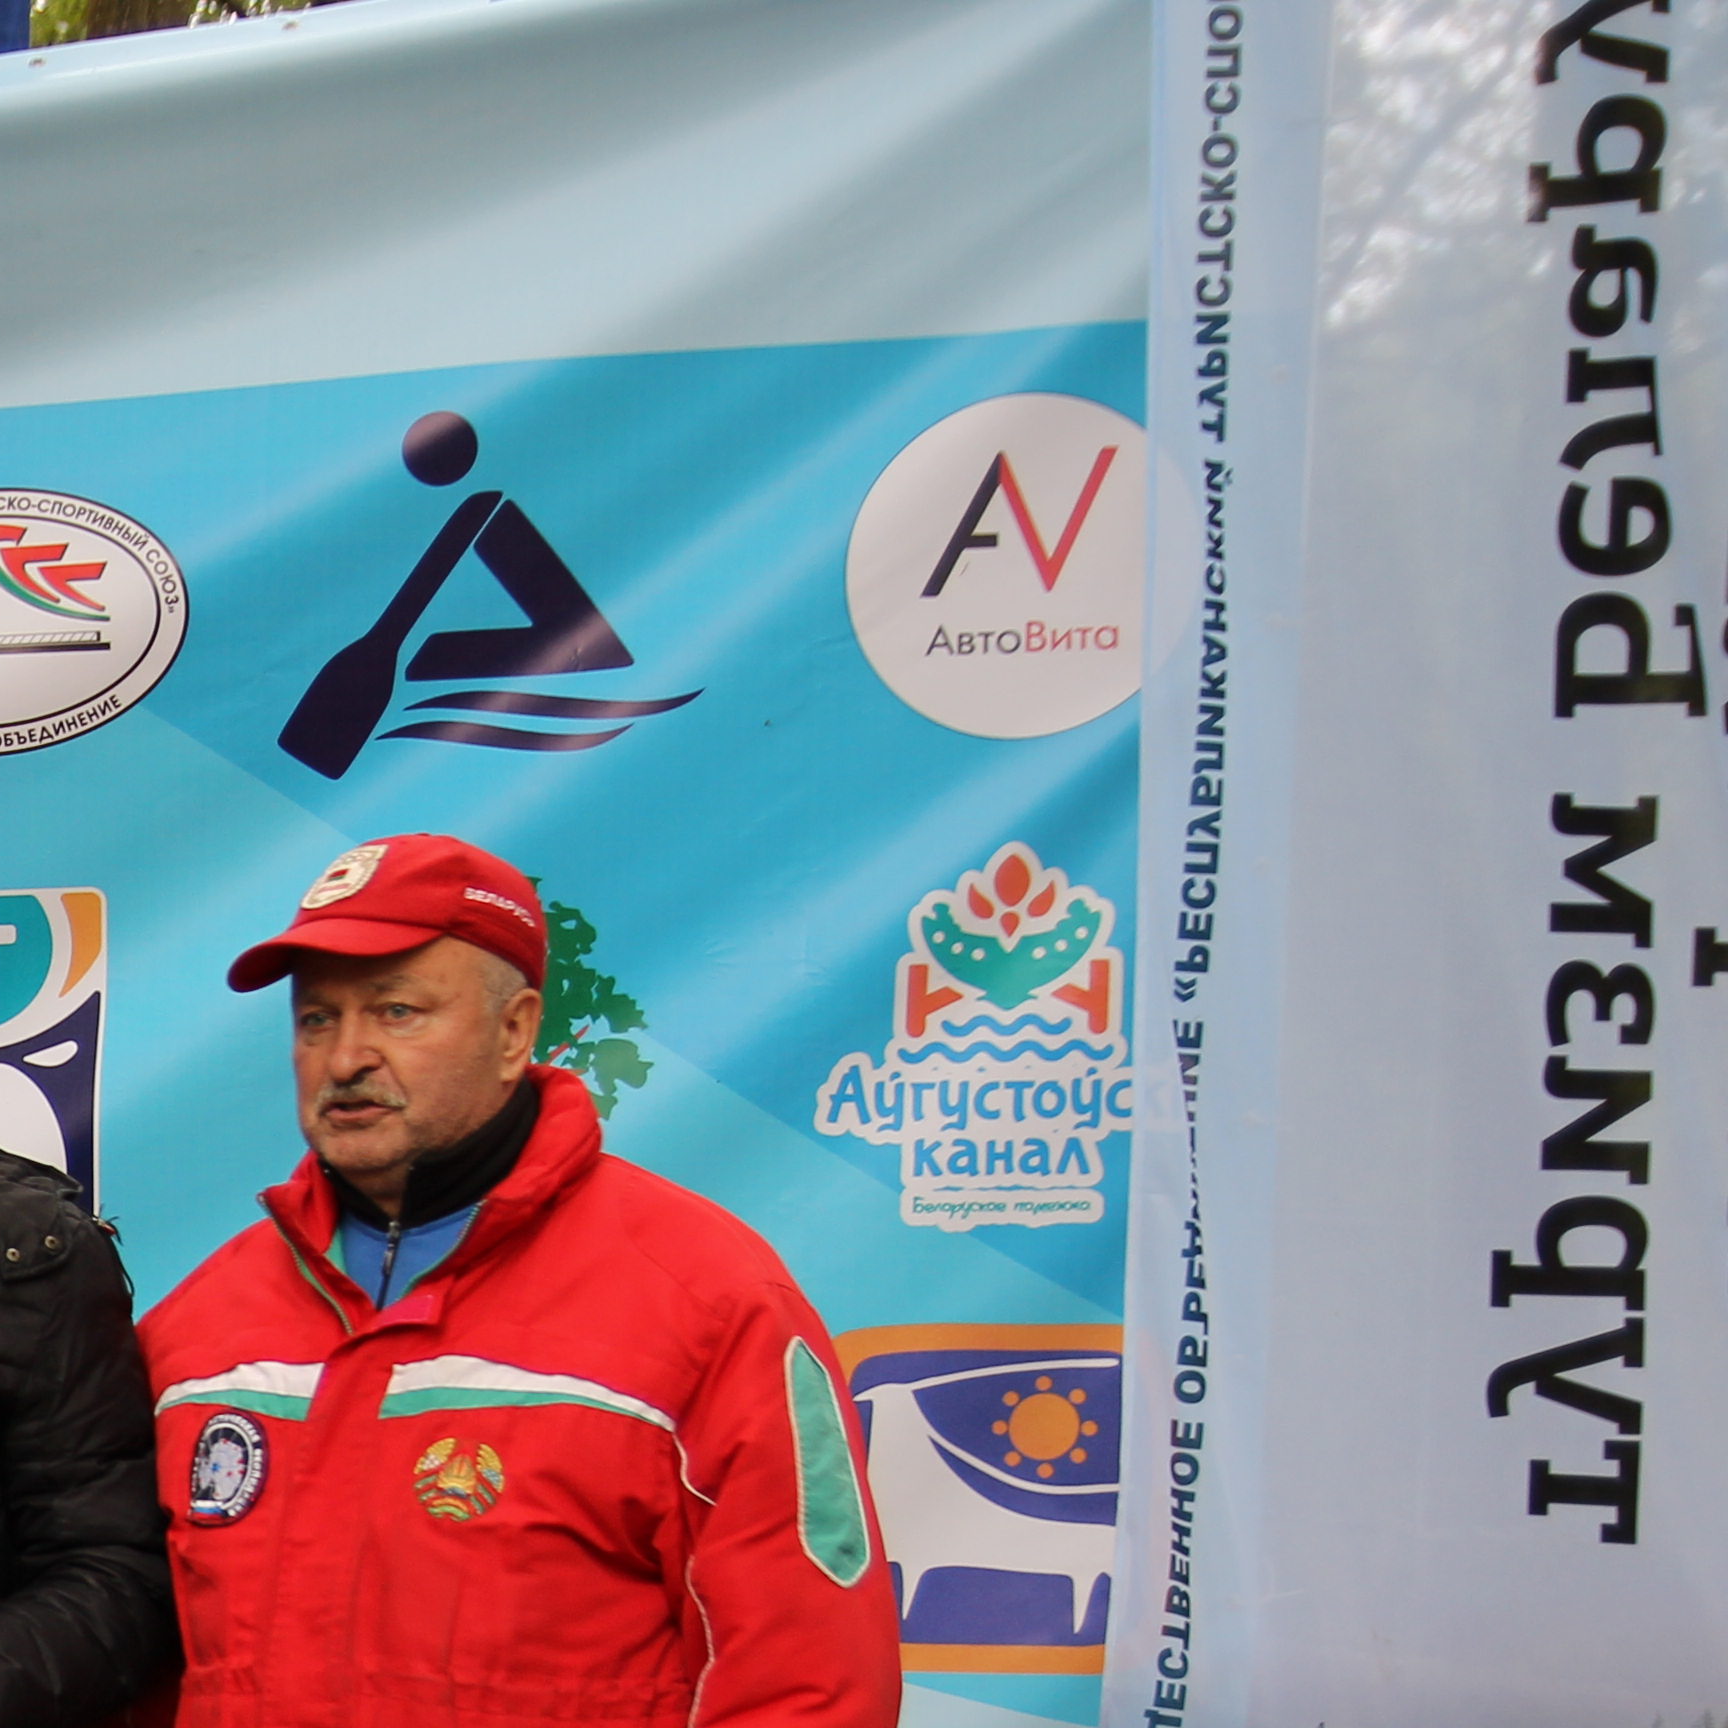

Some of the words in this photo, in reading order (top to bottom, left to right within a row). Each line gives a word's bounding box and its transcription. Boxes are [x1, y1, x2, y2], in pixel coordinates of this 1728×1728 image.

[926, 620, 1120, 656] АвтоВита
[828, 1066, 1133, 1132] Аўгустоўс
[912, 1137, 1091, 1177] канал
